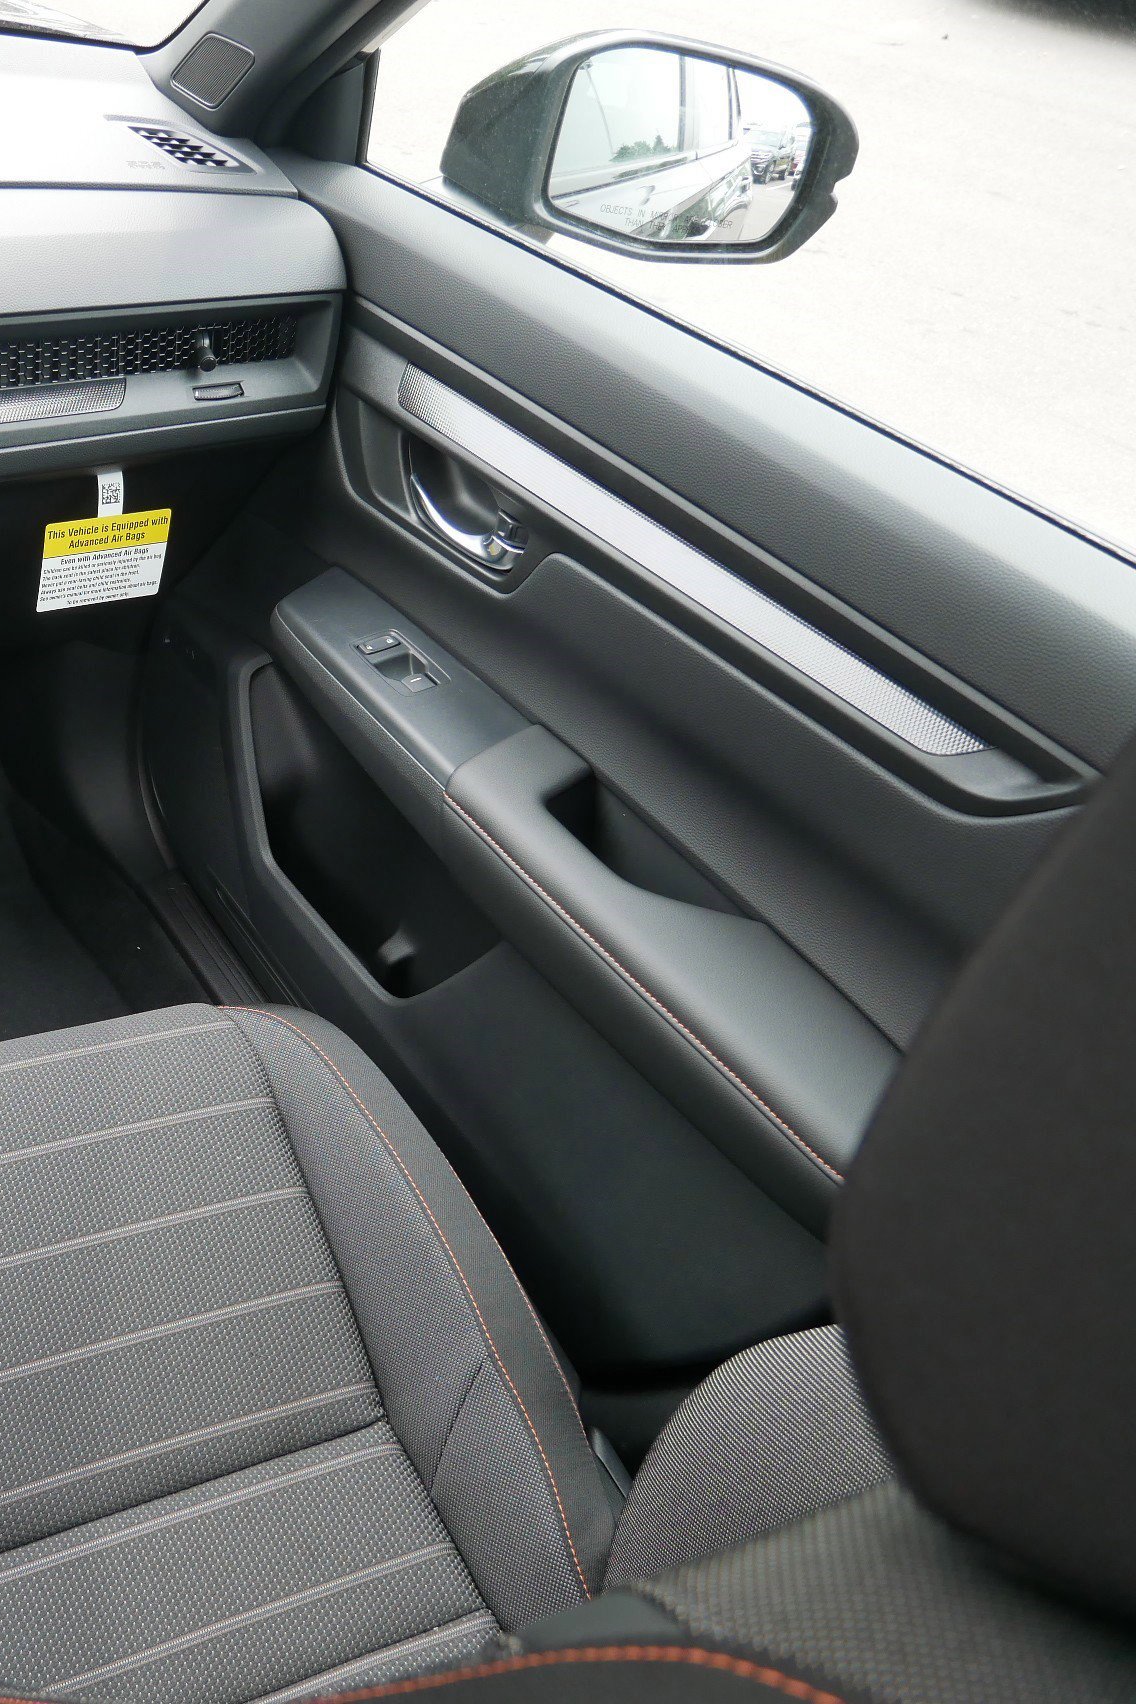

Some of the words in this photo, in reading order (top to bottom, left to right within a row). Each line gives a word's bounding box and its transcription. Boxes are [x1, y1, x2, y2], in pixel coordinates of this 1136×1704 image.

[600, 204, 632, 215] OBJECTS
[625, 218, 643, 227] THAN
[48, 530, 65, 540] This
[68, 526, 99, 537] Vehicle
[102, 524, 109, 533] is
[111, 518, 149, 532] Equipped
[151, 516, 169, 526] with
[69, 535, 109, 549] Advanced
[111, 534, 124, 543] Air
[125, 531, 145, 543] Bags
[77, 555, 91, 563] with
[92, 551, 122, 561] Advanced
